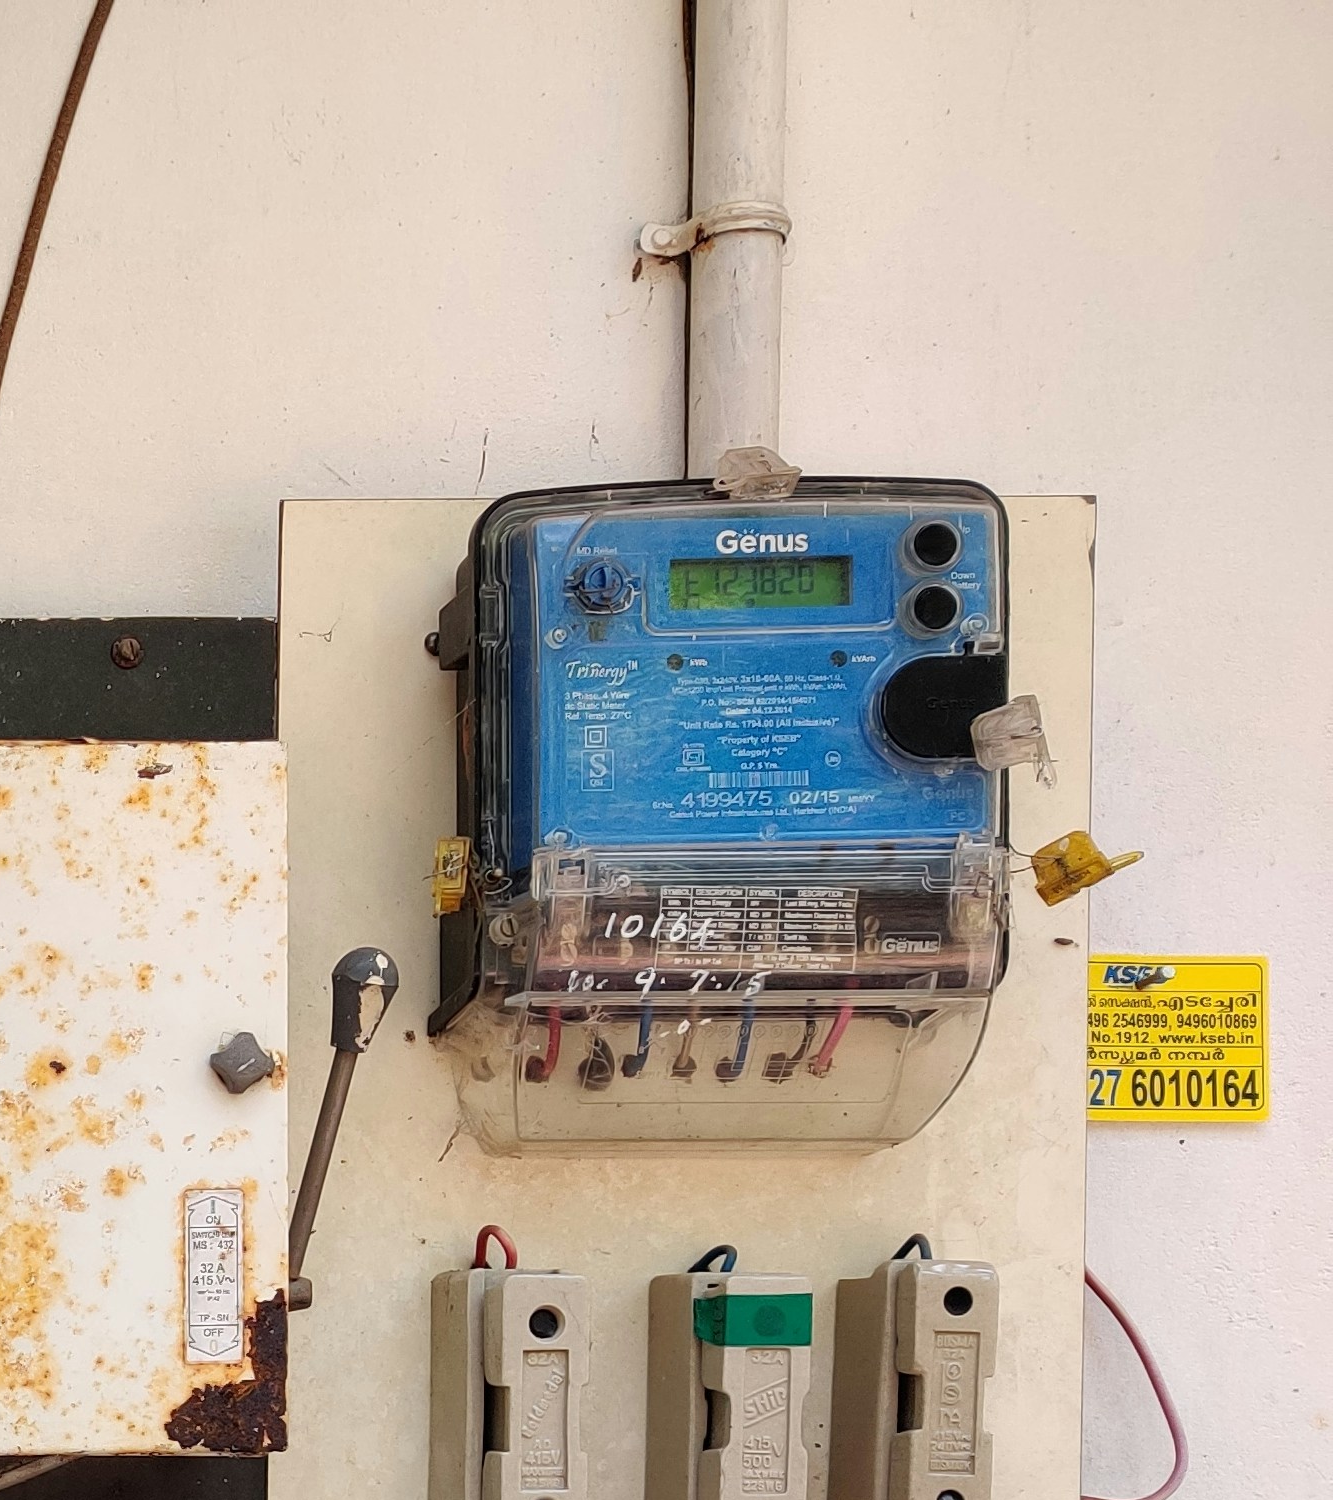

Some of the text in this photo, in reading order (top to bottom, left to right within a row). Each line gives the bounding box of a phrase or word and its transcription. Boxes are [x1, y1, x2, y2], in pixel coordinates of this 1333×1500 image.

[715, 528, 809, 554] Genus
[950, 571, 976, 580] Down
[731, 747, 771, 758] Category
[680, 789, 773, 808] 4199475
[788, 790, 840, 805] 02/15
[1176, 1013, 1258, 1029] 9496010869
[1158, 1031, 1255, 1045] www.kseb.in
[1089, 1068, 1260, 1108] 27 6010164
[205, 1215, 222, 1226] ON
[193, 1240, 207, 1250] MS
[217, 1239, 234, 1250] 432
[199, 1262, 226, 1274] 32 A
[192, 1275, 214, 1286] 415
[203, 1327, 225, 1338] OFF
[526, 1352, 560, 1367] 32A
[750, 1350, 784, 1365] 32A
[744, 1435, 771, 1449] 415
[743, 1454, 772, 1468] 500
